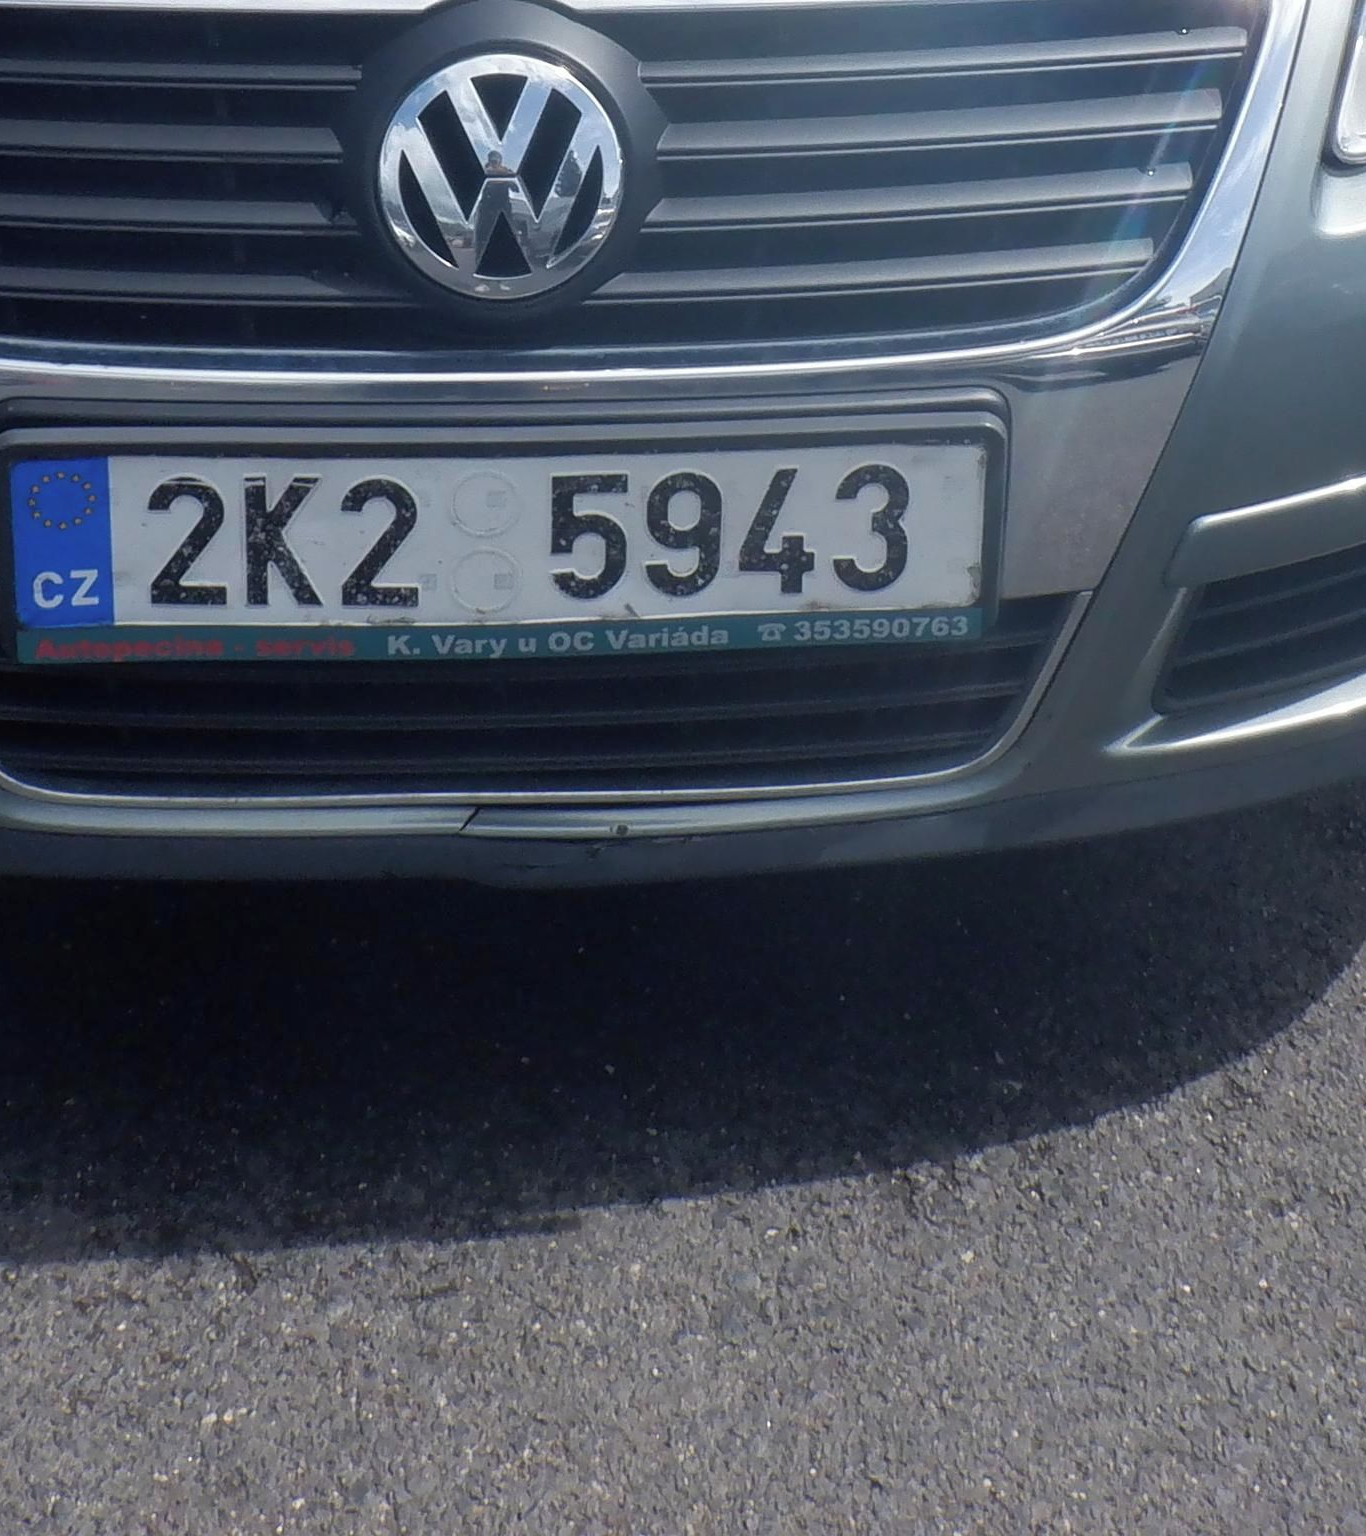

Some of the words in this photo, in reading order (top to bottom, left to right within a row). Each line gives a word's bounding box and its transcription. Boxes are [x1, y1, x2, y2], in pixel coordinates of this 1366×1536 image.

[147, 474, 420, 607] 2K2
[549, 463, 911, 600] 5943
[33, 568, 99, 608] CZ
[387, 634, 421, 656] K.
[431, 633, 507, 659] Vary
[518, 637, 537, 654] u
[547, 630, 595, 653] OC
[605, 624, 730, 651] Variáda
[793, 615, 969, 642] 353590763
